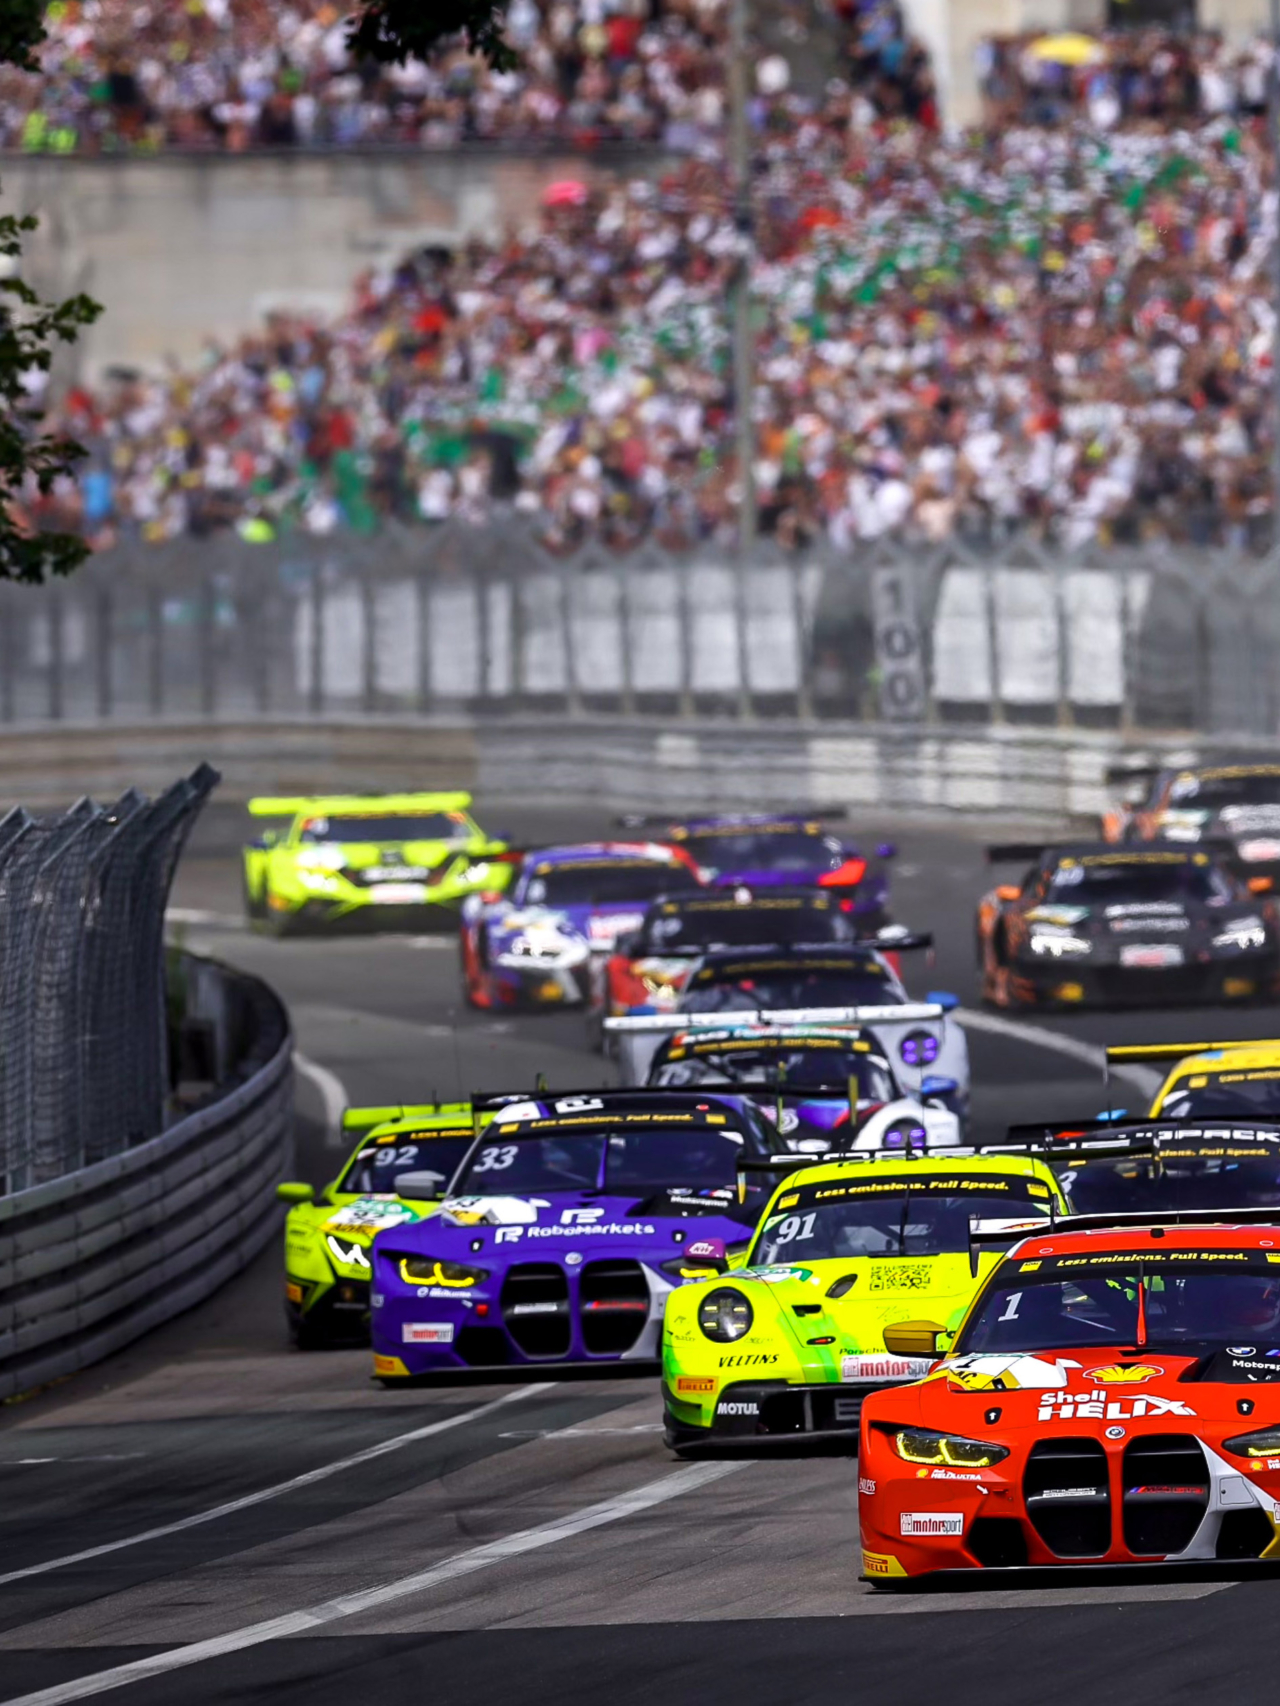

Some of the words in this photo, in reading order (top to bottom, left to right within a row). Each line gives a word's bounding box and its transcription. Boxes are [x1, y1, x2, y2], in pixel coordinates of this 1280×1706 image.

[375, 1145, 419, 1166] 92
[473, 1144, 519, 1173] 33
[815, 1187, 846, 1199] Less
[848, 1182, 926, 1195] emissions.
[929, 1180, 957, 1189] Full
[960, 1180, 1009, 1191] Speed.
[527, 1222, 656, 1239] RoboMarkets
[775, 1213, 817, 1246] 91
[1057, 1256, 1086, 1266] Less
[1089, 1253, 1166, 1265] emissions.
[1170, 1252, 1198, 1261] Full
[1200, 1252, 1248, 1262] Speed.
[998, 1292, 1023, 1322] 1
[718, 1354, 780, 1368] VELTINS
[860, 1360, 932, 1377] motorspor
[1040, 1390, 1107, 1406] Shell
[717, 1402, 760, 1415] MOTUL
[1038, 1394, 1198, 1421] HELIX
[913, 1518, 962, 1534] motorsport
